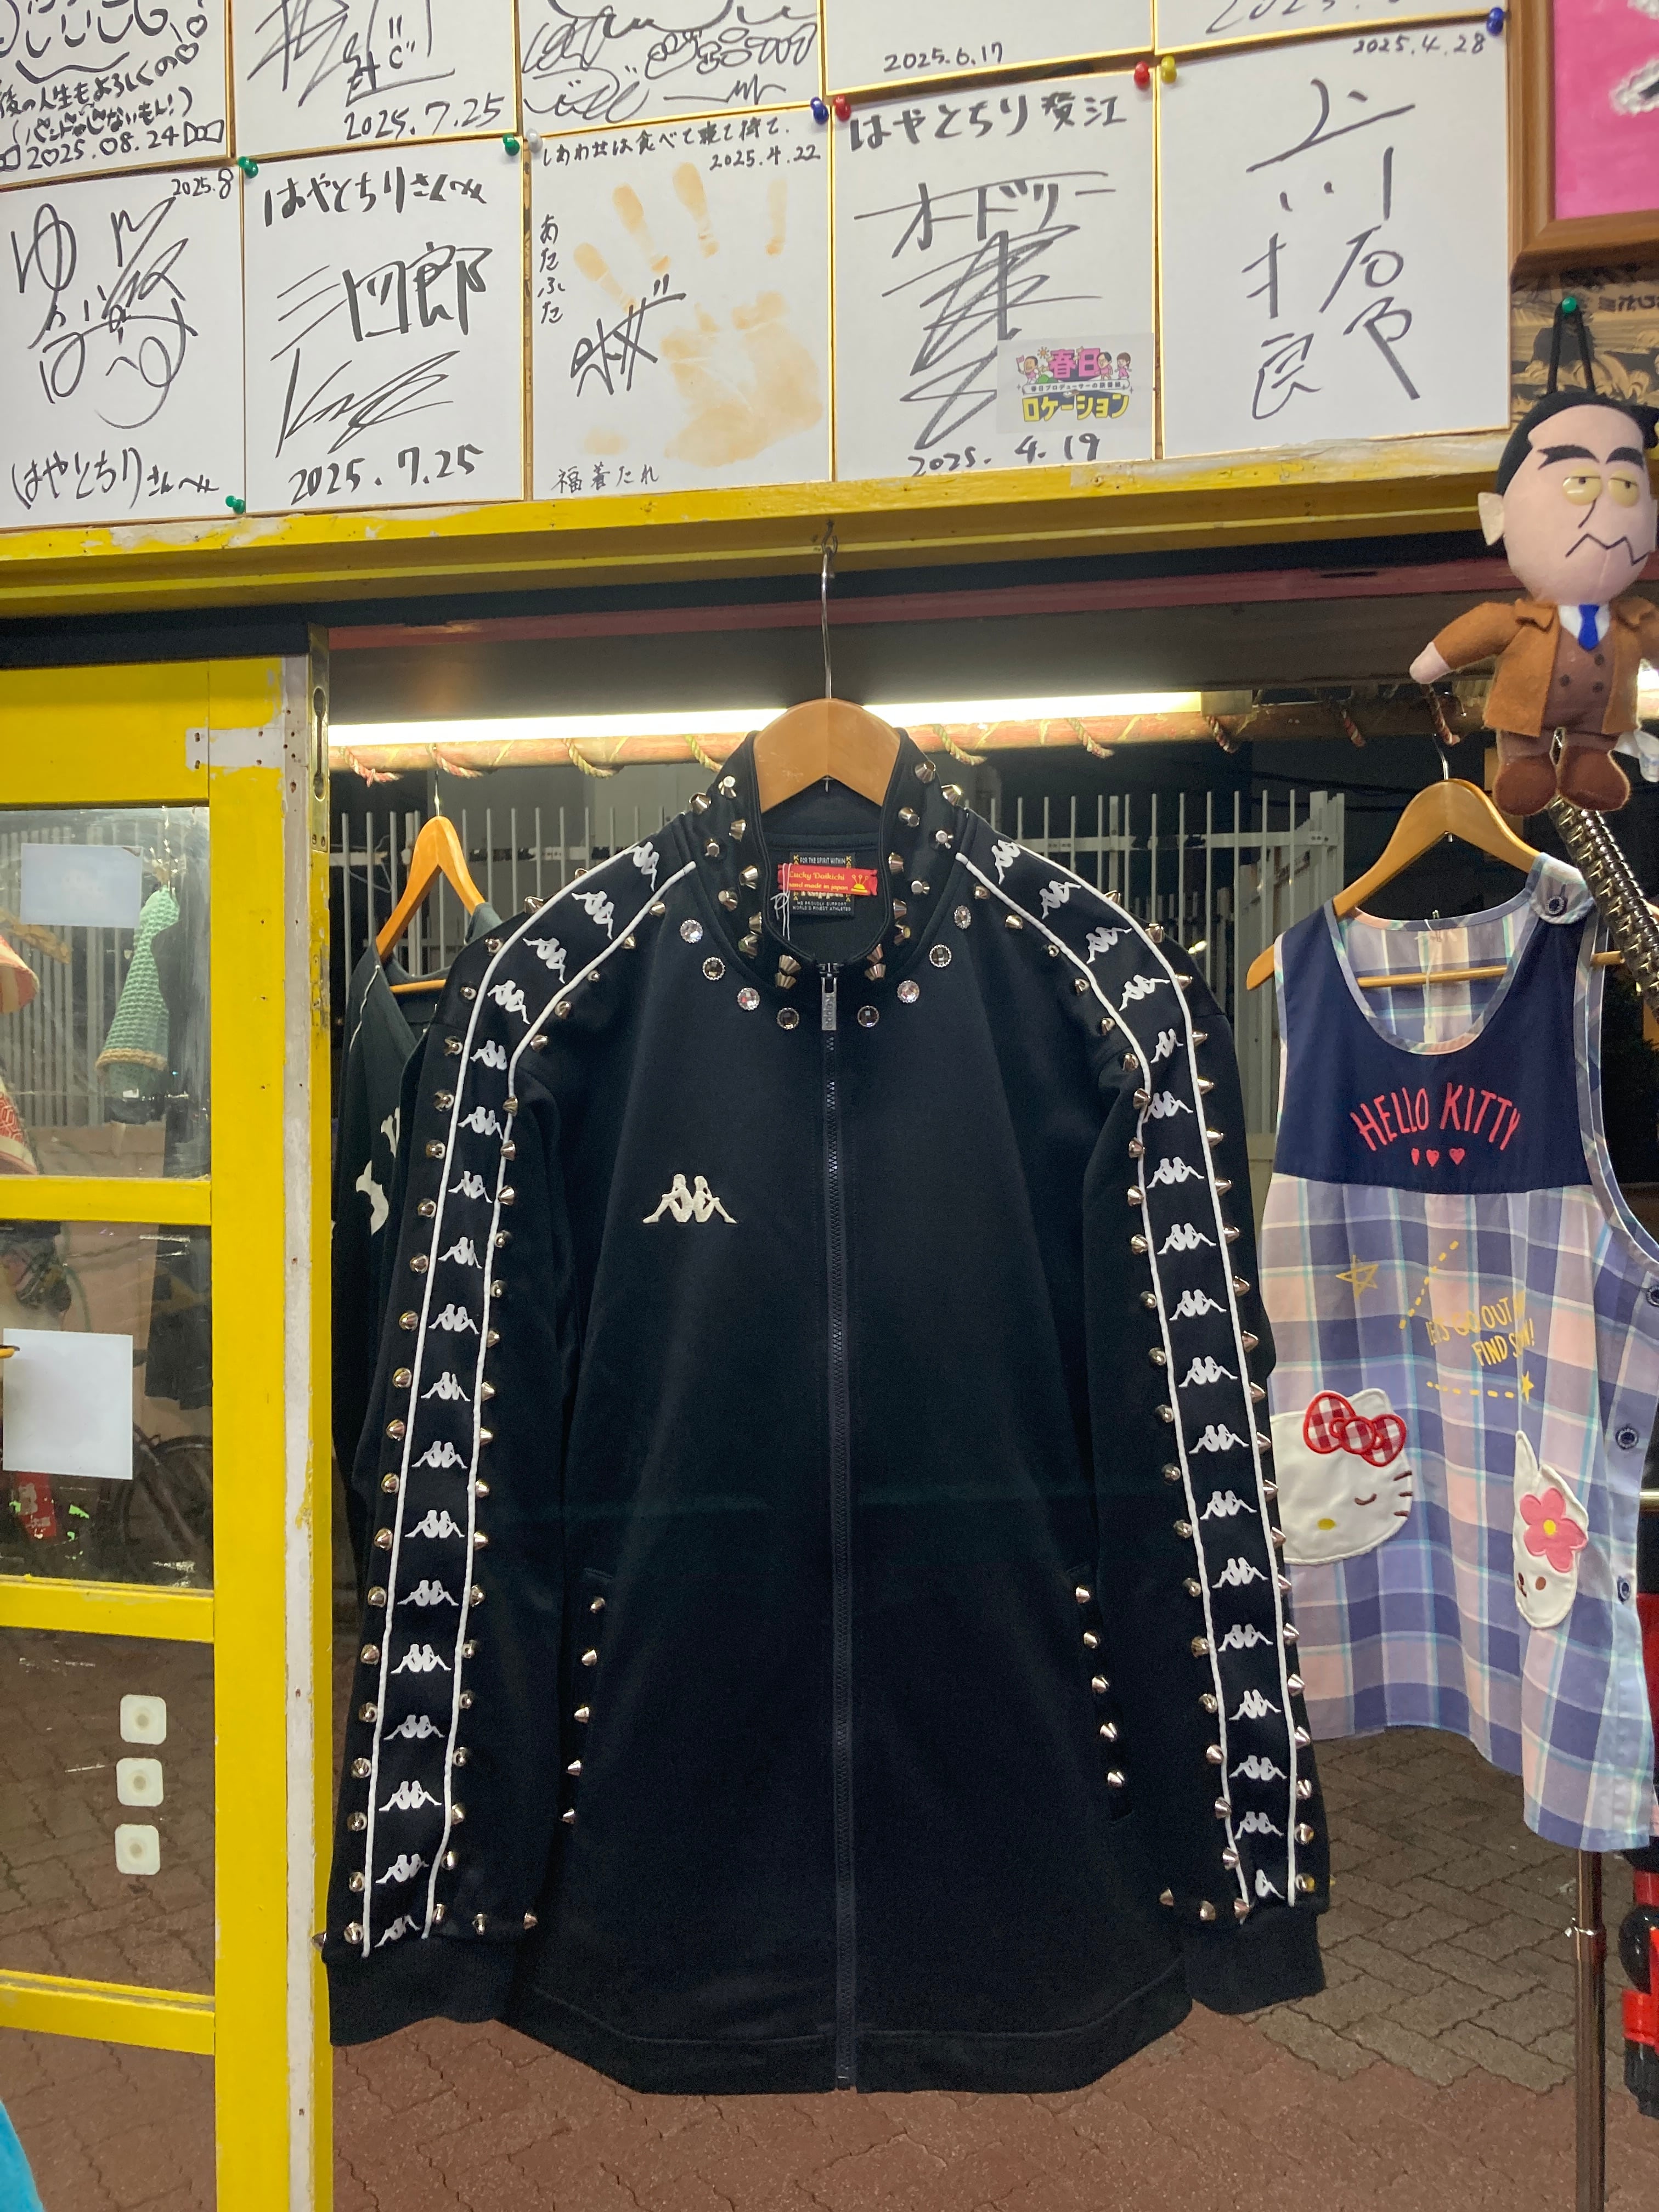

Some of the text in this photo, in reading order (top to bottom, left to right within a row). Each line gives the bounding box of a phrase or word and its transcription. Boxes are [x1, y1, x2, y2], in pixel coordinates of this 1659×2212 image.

[883, 41, 1003, 72] 2025.6.17
[1353, 32, 1486, 54] 2025.4.28
[343, 92, 505, 142] 2025.7.25
[709, 144, 821, 171] 2025.4.22
[171, 168, 234, 199] 2025.8
[1048, 348, 1101, 379] 春日
[1022, 393, 1130, 421] ロケーション
[813, 872, 845, 881] Daikichi
[1350, 1082, 1521, 1151] HELLO KITTY
[1481, 1296, 1513, 1329] OUT
[1471, 1335, 1508, 1367] FIND
